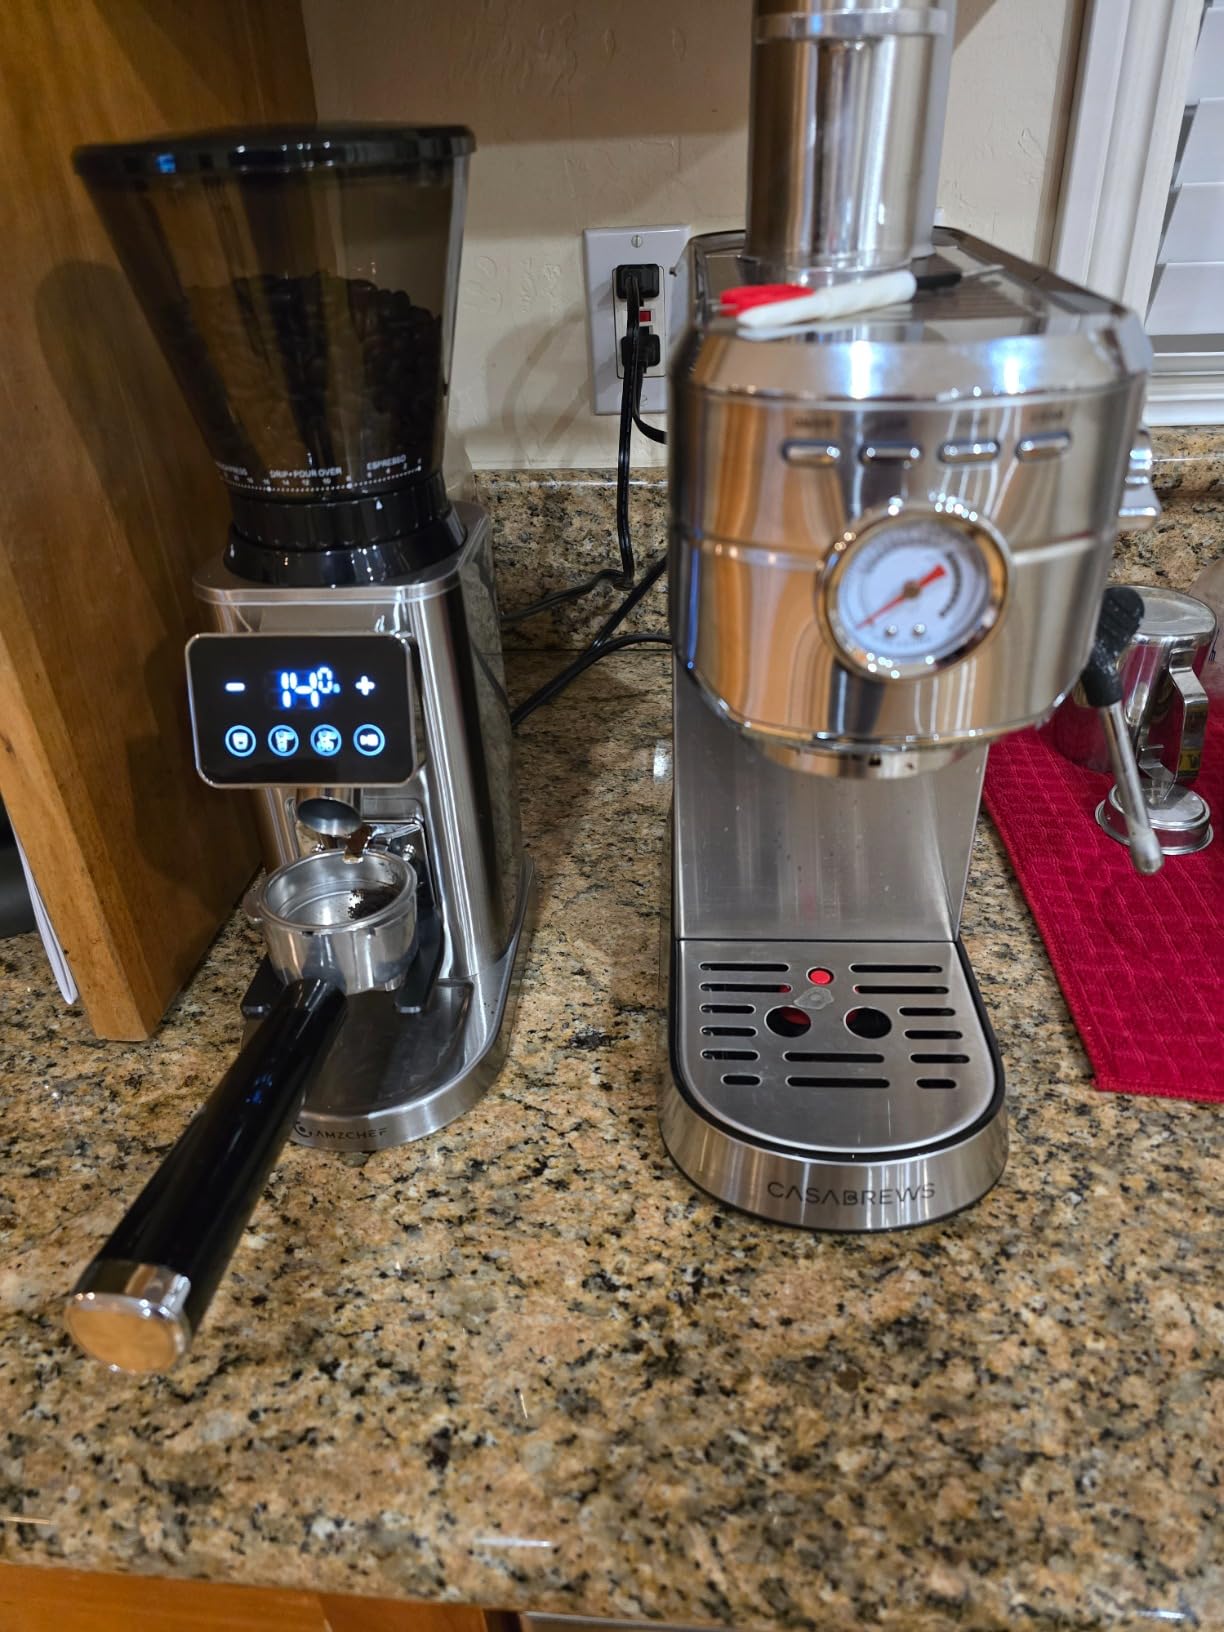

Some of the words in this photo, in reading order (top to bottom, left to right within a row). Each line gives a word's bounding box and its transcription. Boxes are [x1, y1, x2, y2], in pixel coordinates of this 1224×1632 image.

[318, 466, 342, 477] OVER
[316, 1128, 387, 1140] AMZCHEF
[767, 1182, 936, 1206] CASABREWS
